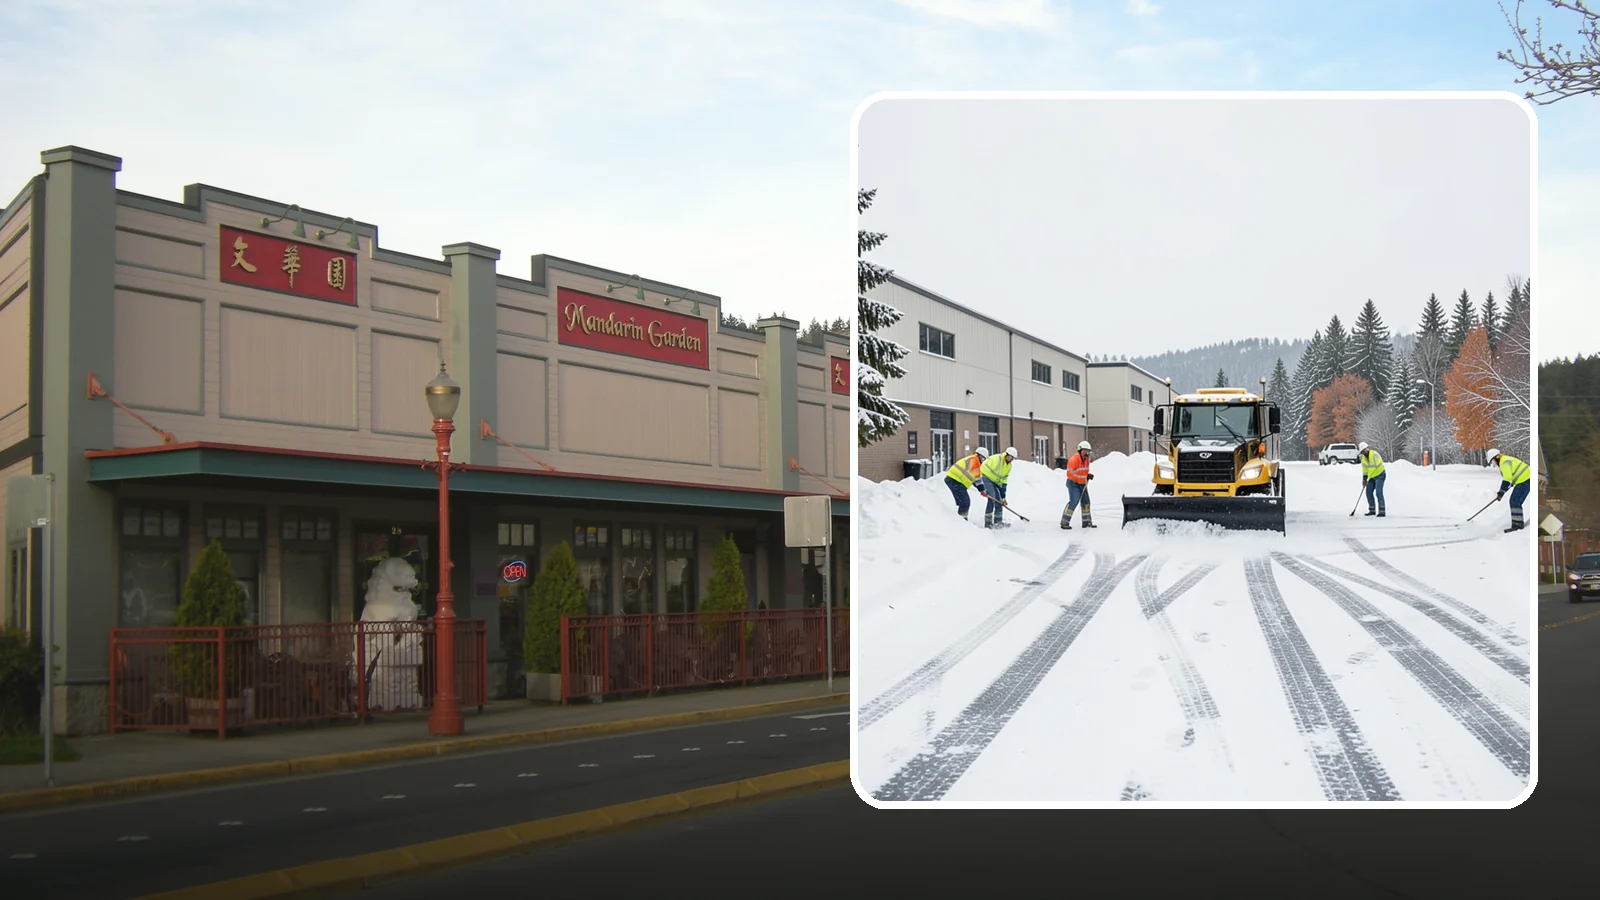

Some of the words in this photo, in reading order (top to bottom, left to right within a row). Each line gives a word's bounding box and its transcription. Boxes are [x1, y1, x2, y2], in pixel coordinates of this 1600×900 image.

[231, 235, 346, 291] 文華園
[565, 303, 643, 340] Mandarin
[648, 320, 702, 352] Garden
[503, 565, 526, 577] OPEN
